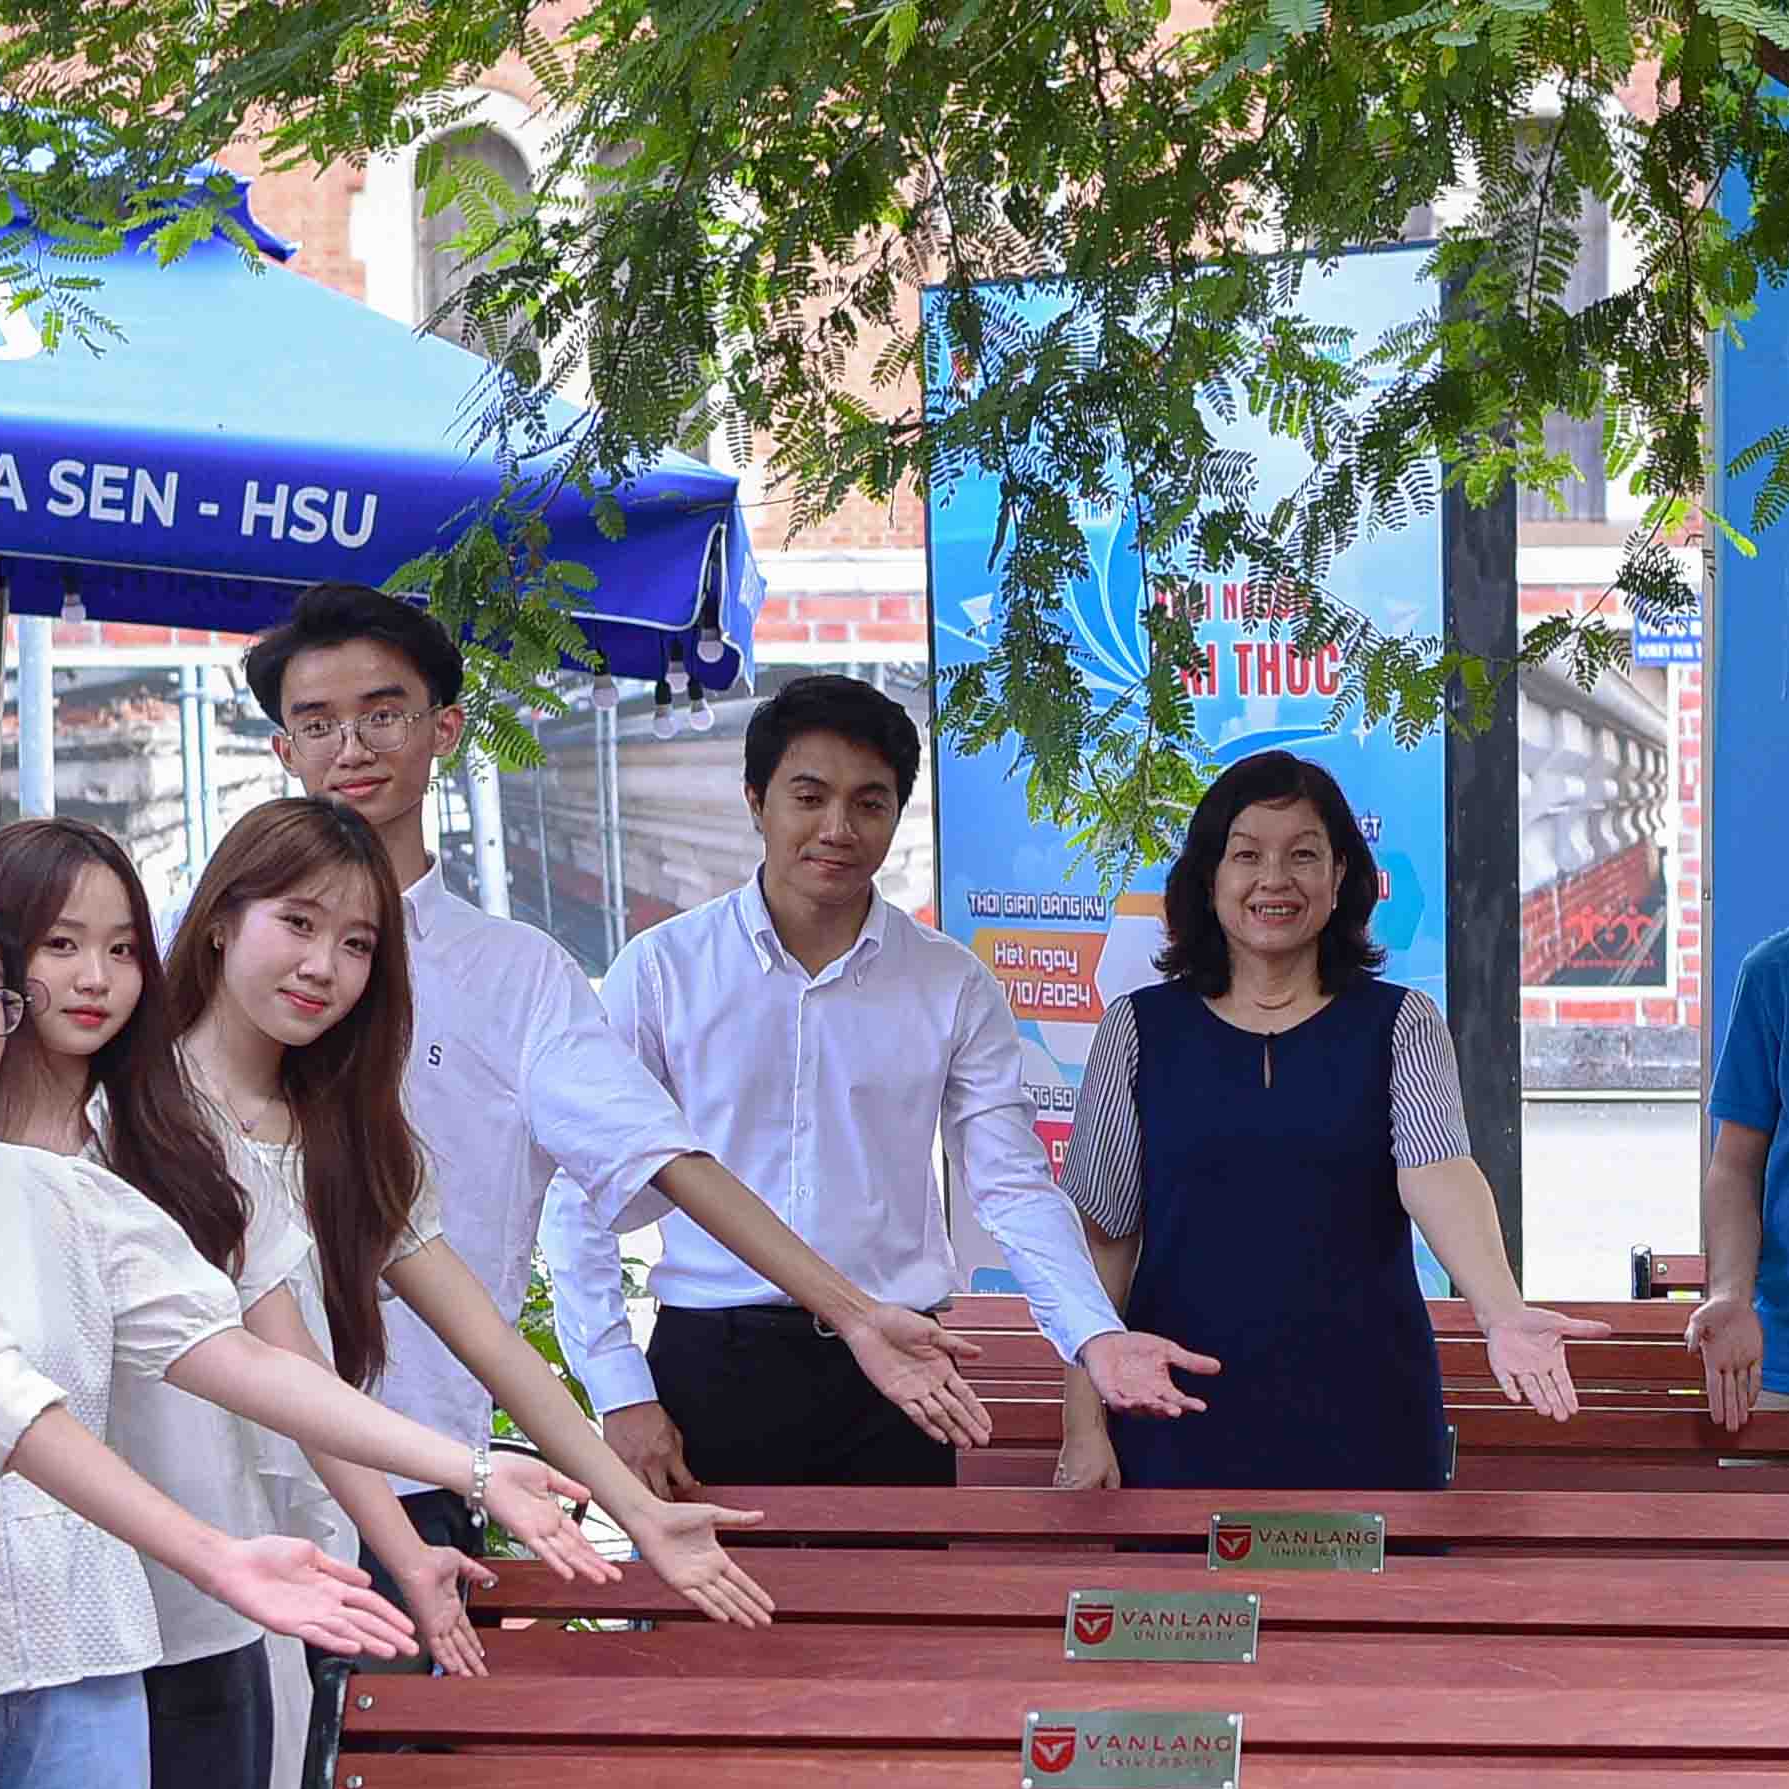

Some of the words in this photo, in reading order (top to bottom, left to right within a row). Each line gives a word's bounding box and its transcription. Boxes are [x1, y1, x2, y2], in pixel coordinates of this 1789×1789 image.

[46, 458, 179, 528] SEN
[198, 503, 220, 517] -
[240, 479, 378, 549] HSU
[1003, 893, 1037, 918] GIAN
[428, 1044, 443, 1067] S
[1258, 1528, 1378, 1545] VANLANG
[1121, 1610, 1251, 1627] VANLANG
[1133, 1631, 1235, 1641] UNIVERSITY
[1085, 1735, 1232, 1751] VANLANG
